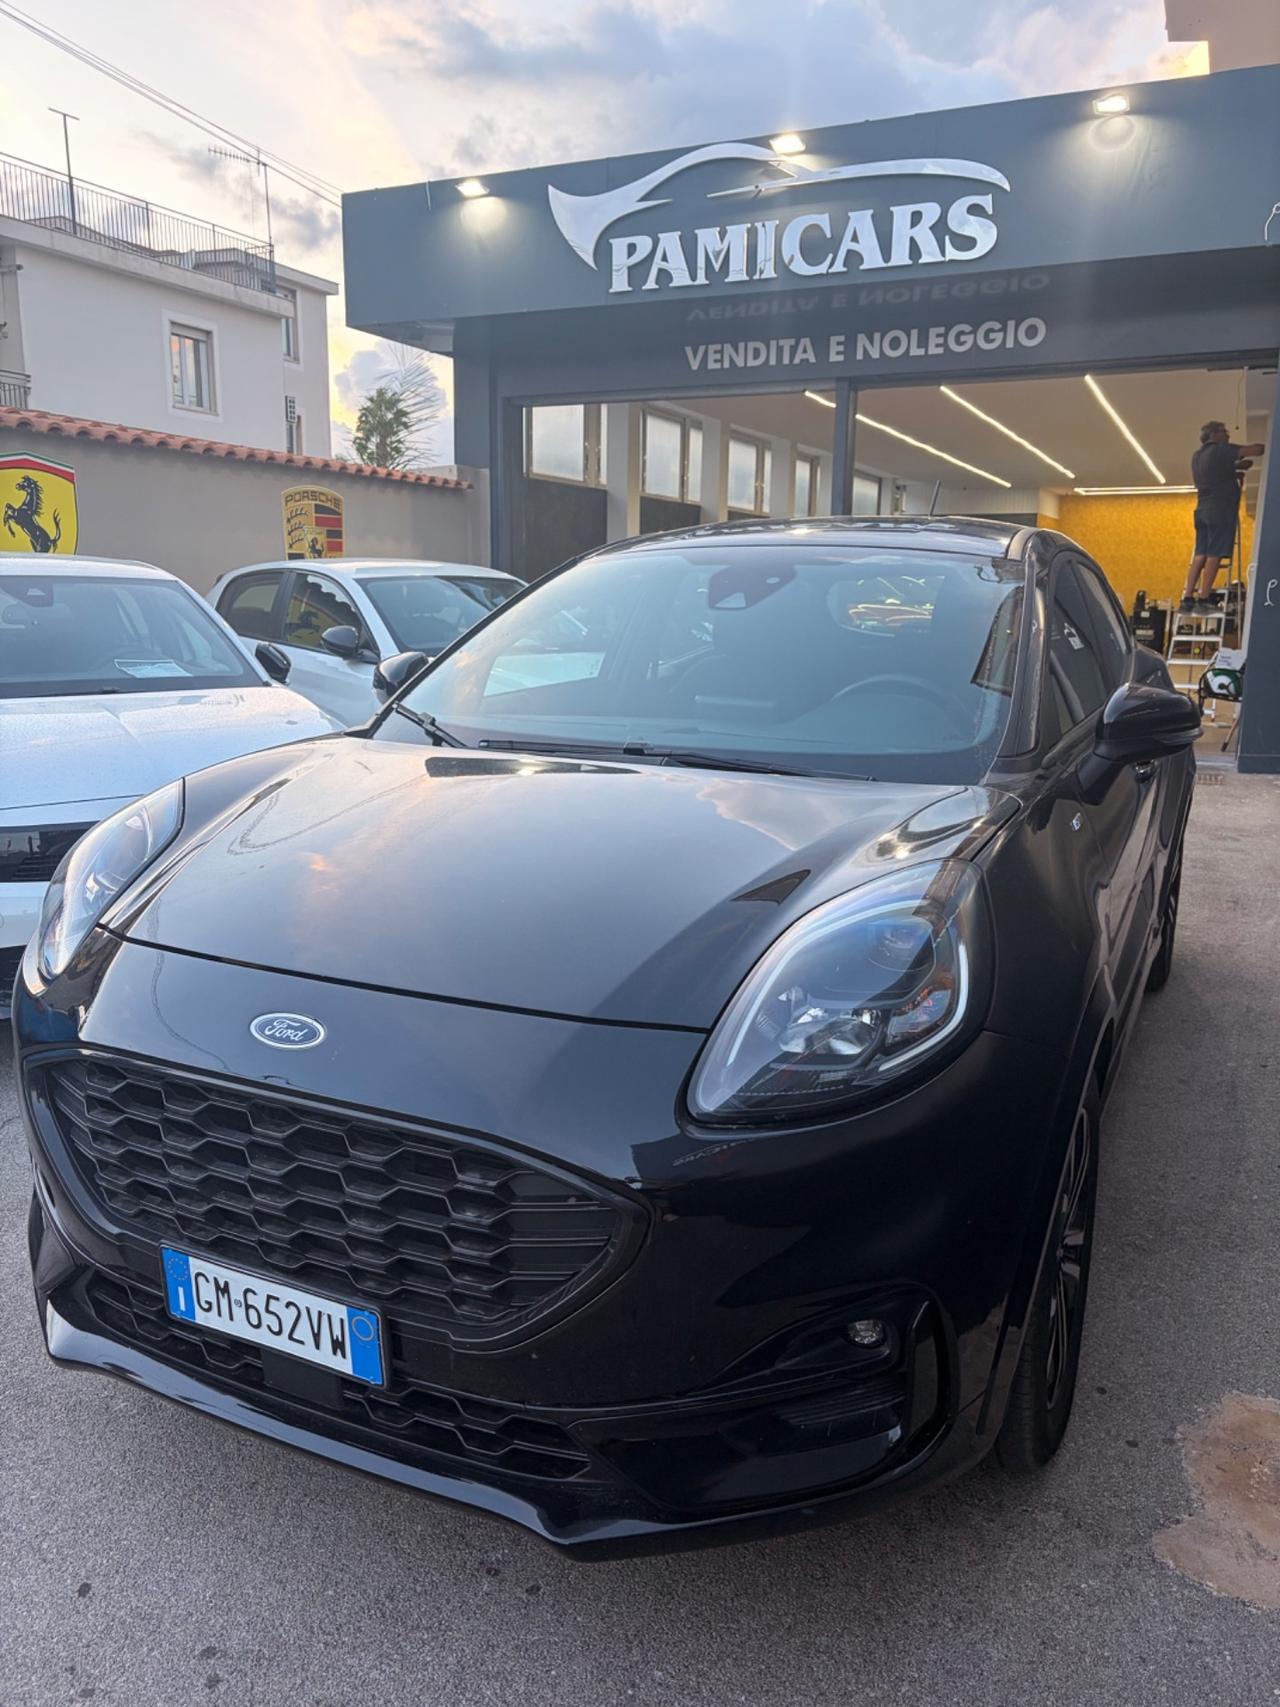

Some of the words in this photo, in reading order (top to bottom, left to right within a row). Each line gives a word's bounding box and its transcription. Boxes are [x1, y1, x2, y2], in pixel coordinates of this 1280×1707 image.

[685, 338, 817, 371] VENDITA
[829, 335, 845, 362] E
[856, 317, 1047, 360] NOLEGGIO
[285, 491, 341, 510] PORSCHE
[264, 1019, 308, 1041] Ford
